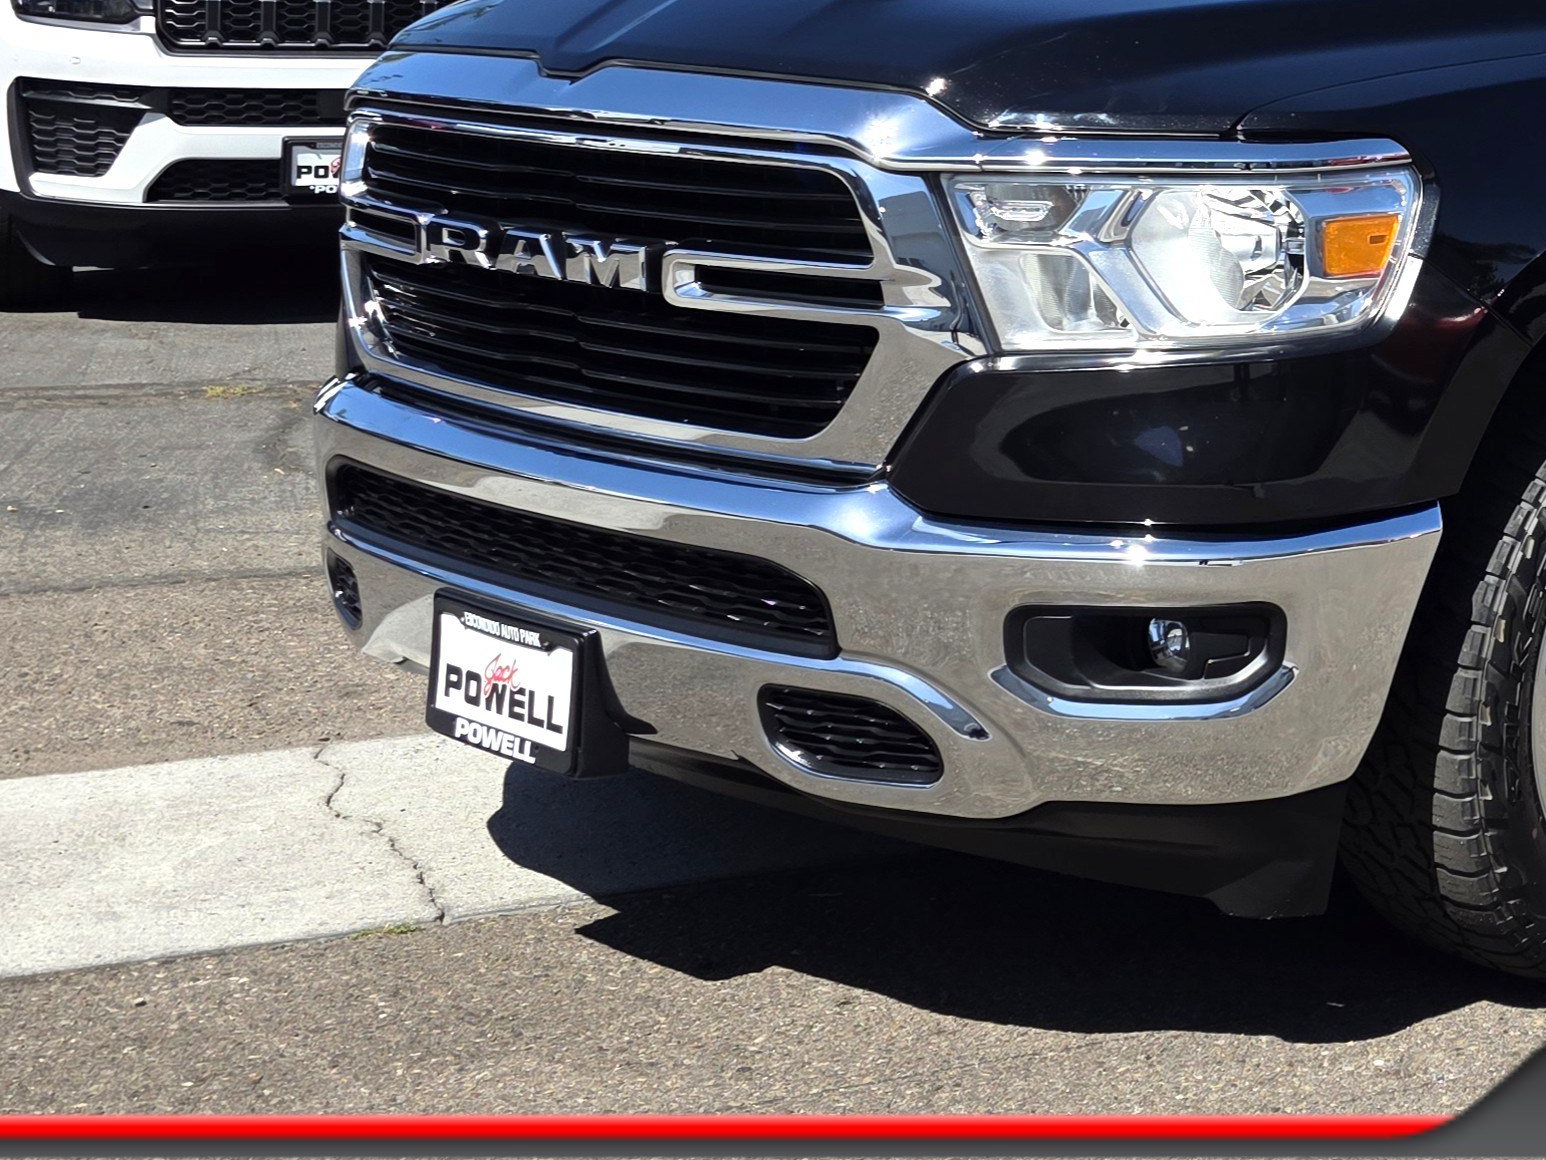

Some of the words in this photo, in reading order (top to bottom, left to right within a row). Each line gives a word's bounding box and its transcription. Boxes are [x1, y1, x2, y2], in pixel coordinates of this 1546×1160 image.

[425, 214, 649, 293] RAM
[501, 623, 520, 642] AUTO
[519, 628, 542, 648] PARK
[444, 663, 564, 735] POWELL
[482, 653, 521, 697] Jack
[454, 716, 537, 765] POWELL
